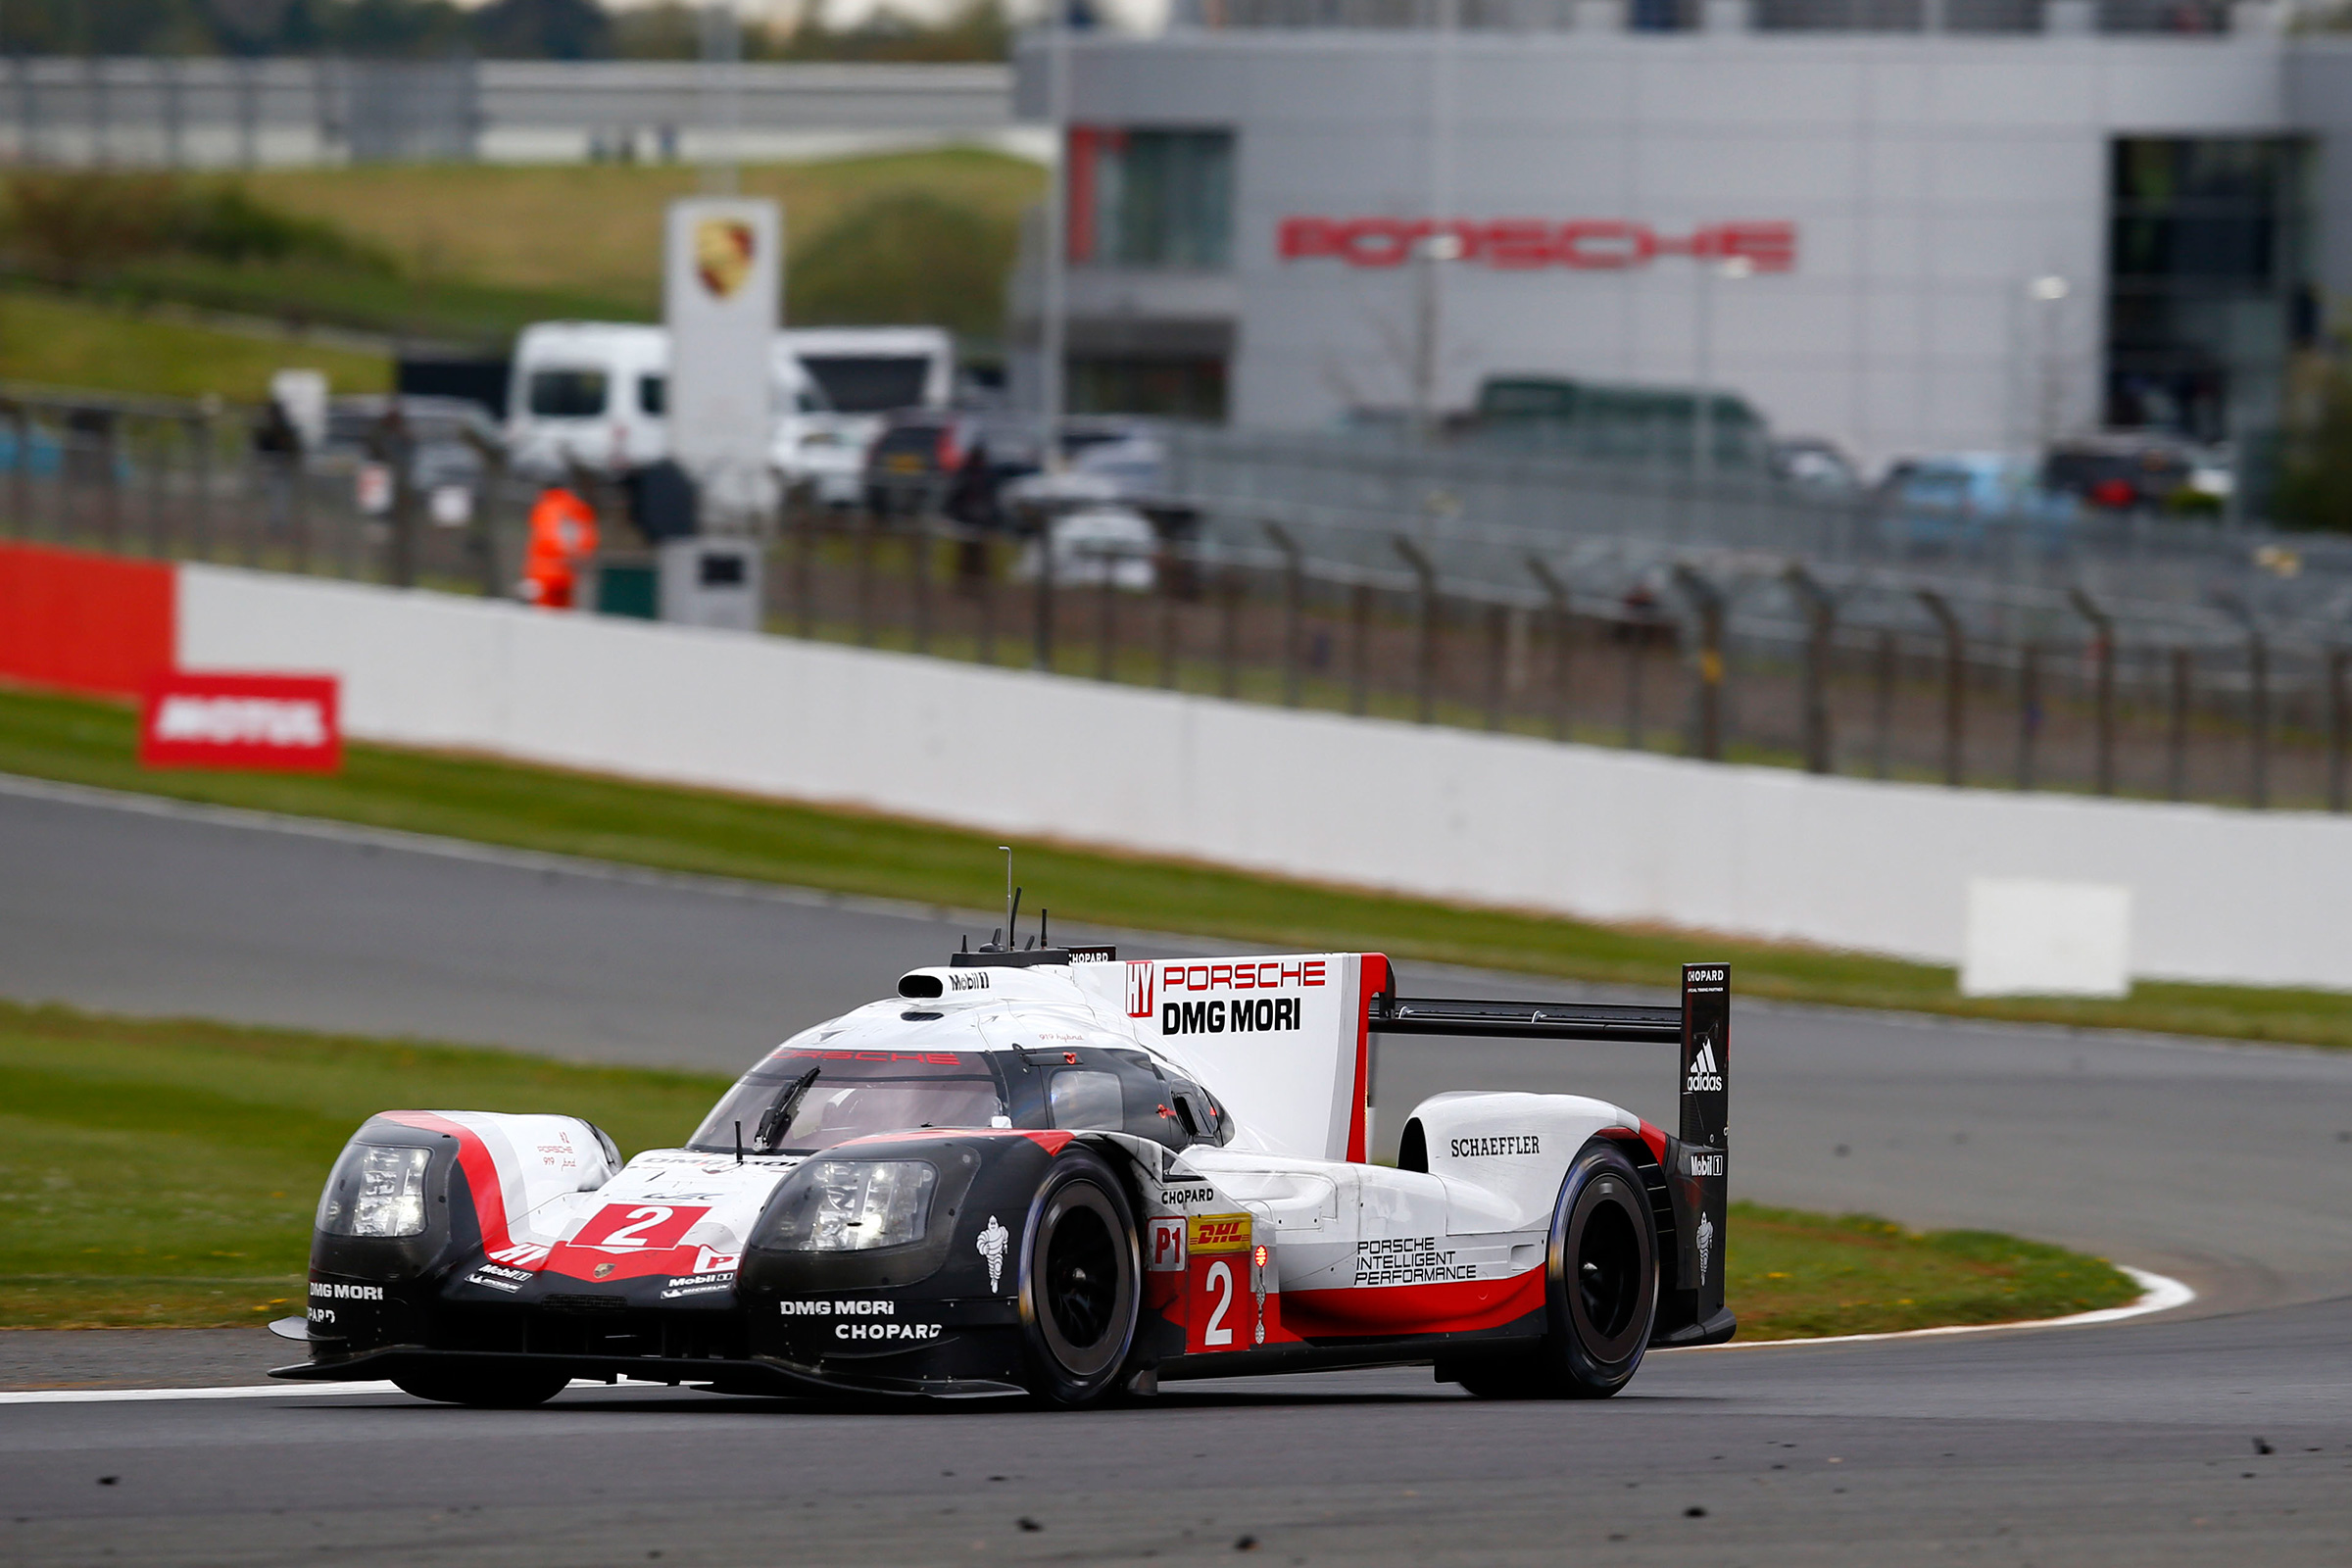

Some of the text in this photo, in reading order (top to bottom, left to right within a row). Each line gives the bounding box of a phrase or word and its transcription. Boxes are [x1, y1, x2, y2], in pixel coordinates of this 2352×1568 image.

[949, 973, 979, 991] Mobil
[1163, 960, 1326, 992] PORSCHE
[1687, 970, 1724, 982] CHOPARD
[1127, 963, 1153, 1014] HY
[1163, 998, 1300, 1036] DMG MORI
[1687, 1072, 1722, 1092] adidas
[1450, 1136, 1540, 1157] SCHAEFFLER
[1690, 1155, 1712, 1176] Mobil
[1160, 1188, 1213, 1204] CHOPARD
[600, 1205, 674, 1247] 2
[1197, 1222, 1242, 1245] DHL
[1154, 1227, 1181, 1264] P1
[1357, 1237, 1435, 1255] PORSCHE
[1356, 1250, 1456, 1271] INTELLIGENT
[478, 1264, 518, 1279] Mobil
[668, 1274, 716, 1287] Mobil
[1353, 1264, 1477, 1286] PERFORMANCE
[309, 1282, 384, 1300] DMG MORI
[780, 1300, 895, 1316] DMG MORI
[1204, 1260, 1233, 1347] 2
[835, 1323, 943, 1340] CHOPARD
